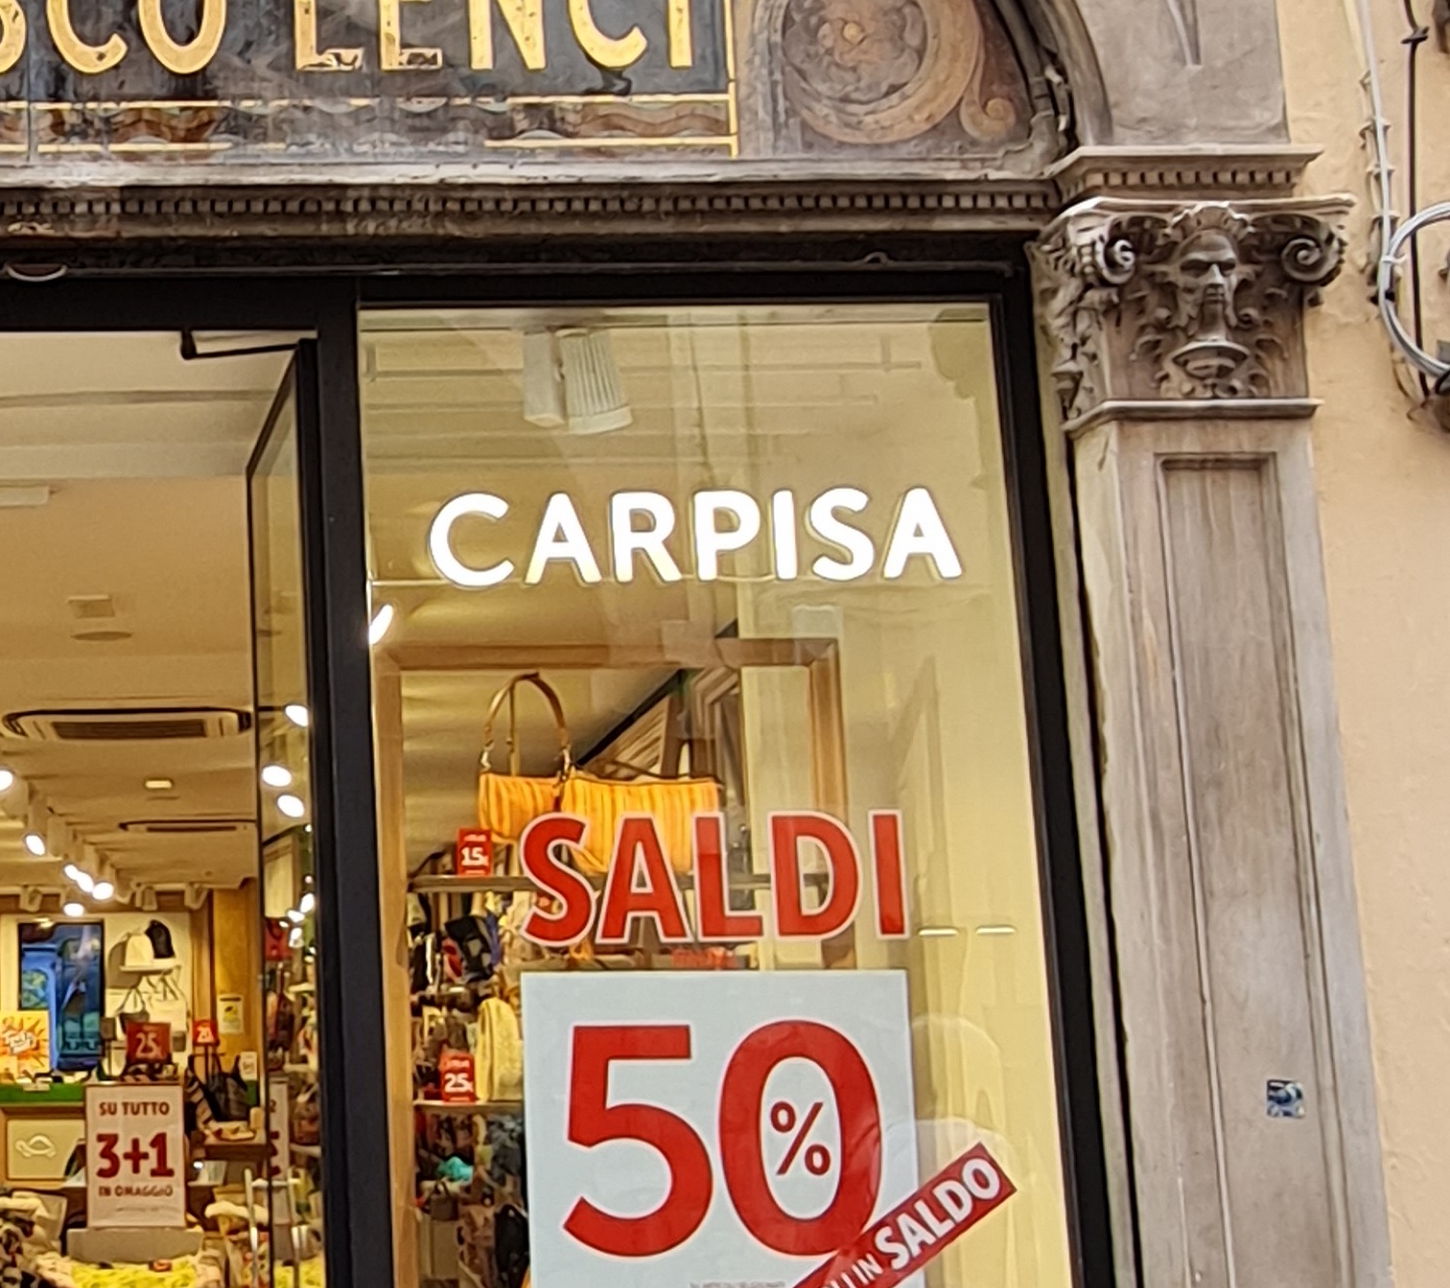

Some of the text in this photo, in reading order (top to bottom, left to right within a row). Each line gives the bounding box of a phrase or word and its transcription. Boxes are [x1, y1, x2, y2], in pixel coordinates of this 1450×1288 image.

[428, 487, 963, 589] CARPISA
[520, 810, 909, 946] SALDI
[99, 1101, 170, 1116] SU TUTTO
[96, 1132, 174, 1178] 3+1
[115, 1184, 173, 1197] OMAGGIO
[851, 1253, 883, 1286] IN
[874, 1158, 1001, 1271] SALDO
